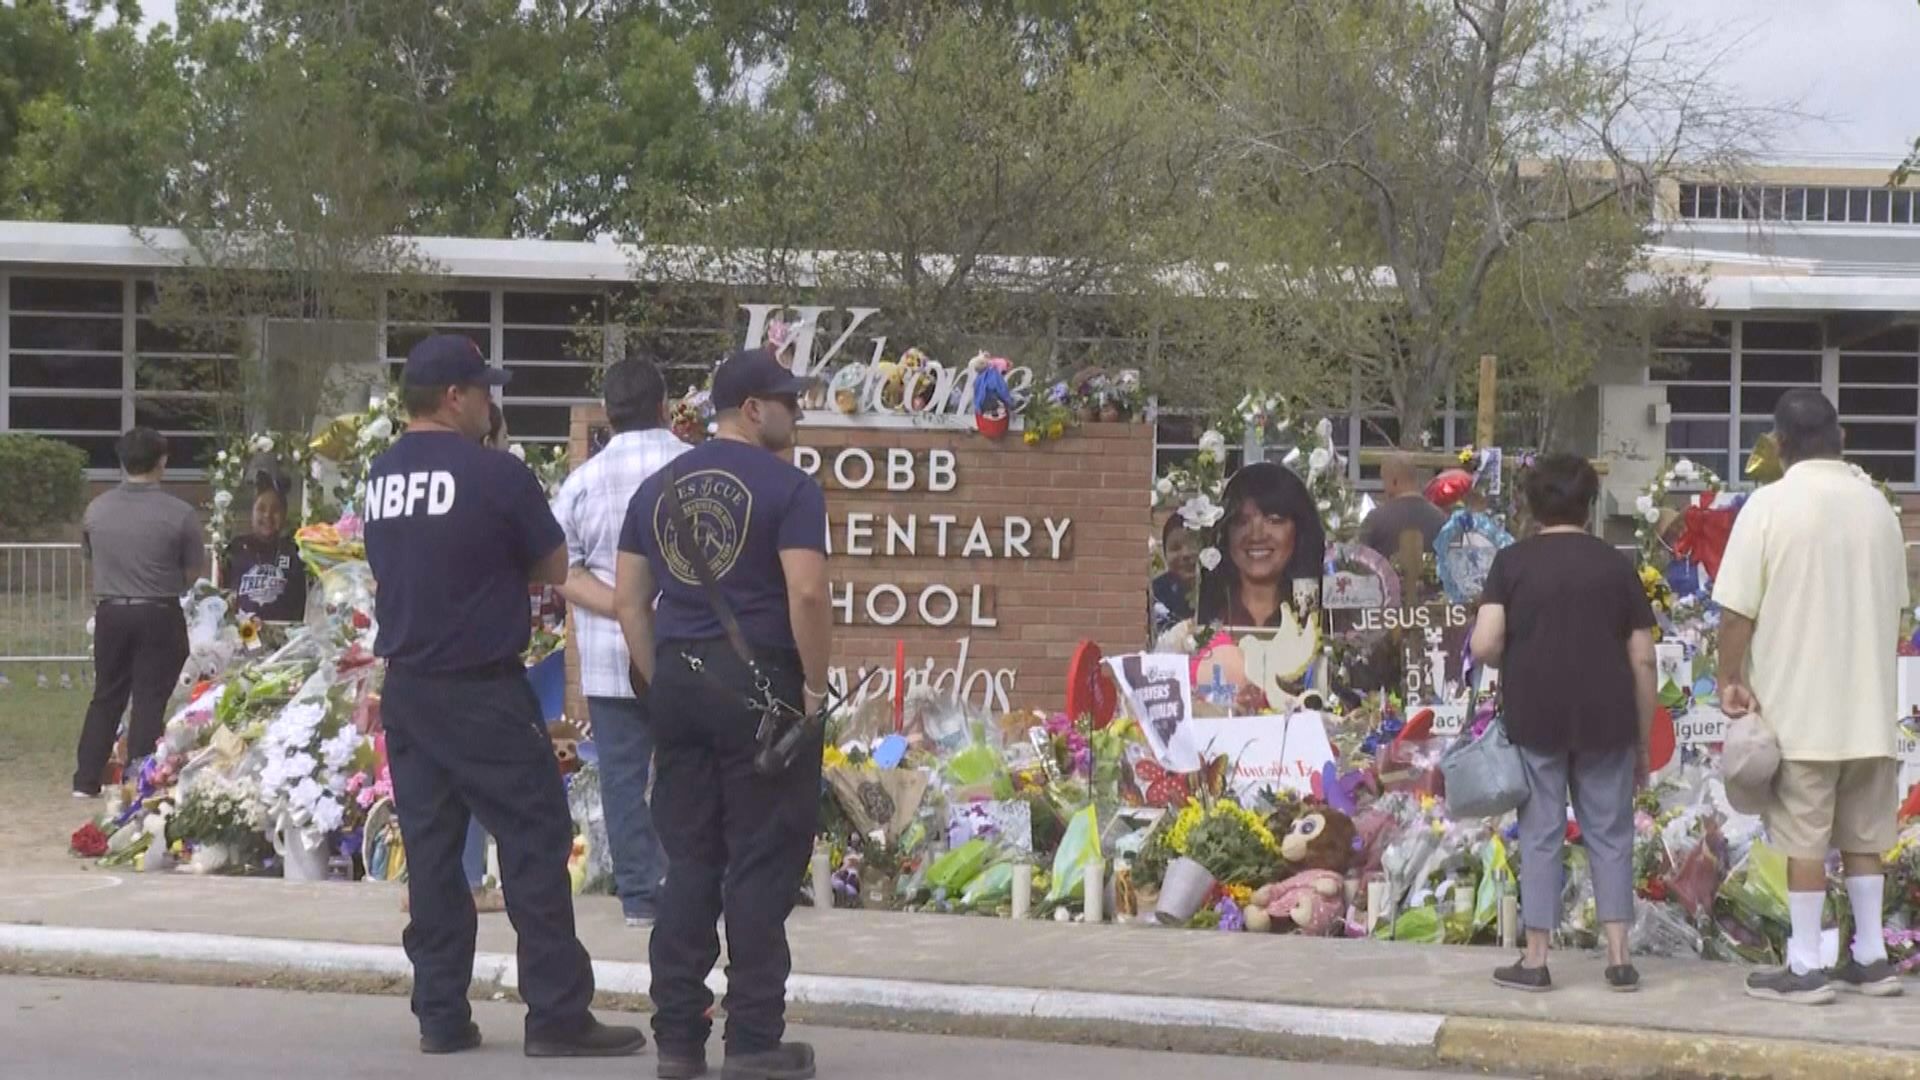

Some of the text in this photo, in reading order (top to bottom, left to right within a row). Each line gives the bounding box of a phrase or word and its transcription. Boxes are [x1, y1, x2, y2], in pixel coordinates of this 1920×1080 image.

[364, 469, 456, 523] NBFD
[825, 512, 1071, 560] ENTARY
[829, 581, 998, 627] HOOL
[1352, 604, 1467, 631] JESUS IS
[1675, 721, 1725, 741] lguer
